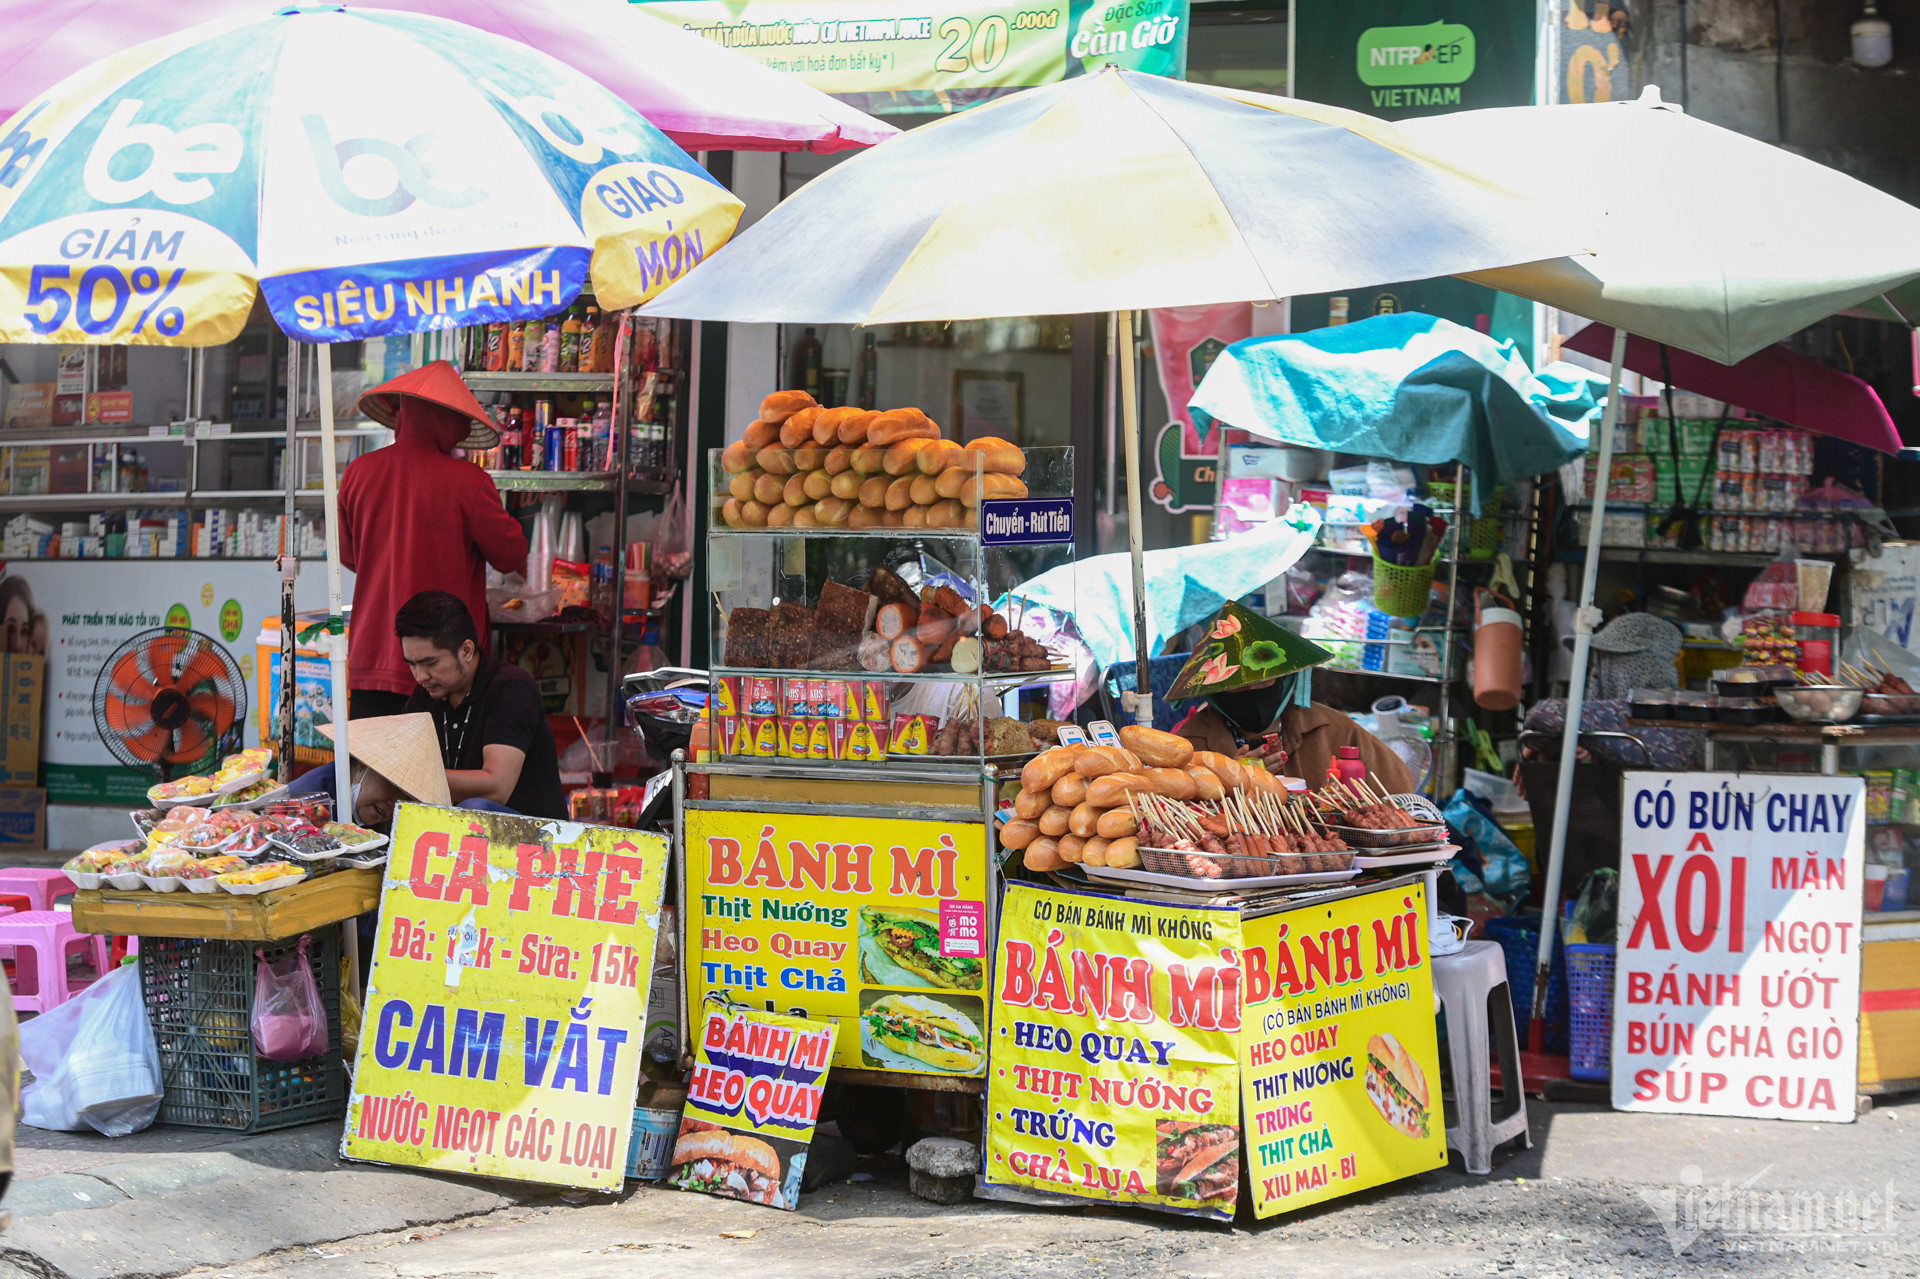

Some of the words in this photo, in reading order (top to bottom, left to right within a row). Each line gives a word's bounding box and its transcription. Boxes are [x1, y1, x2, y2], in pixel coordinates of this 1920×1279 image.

[1070, 20, 1127, 60] Cần
[1131, 14, 1180, 50] Giờ
[1370, 46, 1417, 67] NTFP
[1370, 87, 1461, 108] VIETNAM
[83, 99, 243, 205] be
[595, 168, 685, 220] GIAO
[59, 216, 185, 262] GIẢM
[634, 217, 705, 294] MÓN
[22, 263, 187, 337] 50%
[294, 280, 397, 332] SIÊU
[403, 268, 561, 317] NHANH
[985, 507, 1024, 536] Chuyển
[1030, 511, 1048, 533] Rút
[1048, 507, 1070, 532] Tiền
[1634, 779, 1675, 831] CÓ
[1688, 780, 1755, 832] BÚN
[1766, 792, 1852, 835] CHAY
[408, 820, 491, 907] CÀ
[508, 840, 643, 926] PHÊ
[706, 824, 874, 894] BÁNH
[888, 833, 961, 899] MÌ
[1771, 850, 1847, 899] MẶN
[701, 894, 753, 922] Thịt
[762, 898, 849, 928] Nướng
[1626, 832, 1748, 955] XÔI
[701, 928, 760, 954] Heo
[770, 933, 848, 962] Quay
[1033, 899, 1054, 922] CÓ
[1055, 902, 1082, 927] BÁN
[1085, 906, 1125, 932] BÁNH
[1131, 913, 1154, 937] MÌ
[1157, 915, 1214, 941] KHÔNG
[1764, 920, 1854, 963] NGỌT
[389, 915, 436, 962] Đá:
[518, 934, 581, 981] Sữa:
[589, 941, 640, 988] 15k
[1242, 923, 1366, 1007] BÁNH
[1374, 895, 1425, 977] MÌ
[702, 962, 768, 992] Thịt
[780, 967, 848, 994] Chả
[1000, 927, 1156, 1025] BÁNH
[1168, 947, 1242, 1033] MÌ
[1627, 963, 1741, 1008] BÁNH
[1760, 966, 1840, 1011] ƯỚT
[1262, 1010, 1285, 1036] (CÓ
[1285, 1003, 1312, 1026] BÁN
[1313, 996, 1350, 1021] BÁNH
[1350, 991, 1365, 1015] MÌ
[1365, 980, 1412, 1013] KHÔNG)
[373, 998, 506, 1084] CAM
[522, 996, 629, 1096] VẮT
[704, 1014, 791, 1063] BÁNH
[792, 1023, 832, 1070] MÌ
[1013, 1021, 1073, 1055] HEO
[1079, 1031, 1177, 1068] QUAY
[1249, 1037, 1287, 1068] HEO
[1290, 1024, 1341, 1058] QUAY
[1627, 1012, 1695, 1056] BÚN
[1706, 1012, 1775, 1060] CHẢ
[1786, 1016, 1844, 1061] GIÒ
[687, 1066, 747, 1105] HEO
[747, 1077, 825, 1123] QUAY
[1012, 1062, 1083, 1106] THỊT
[1088, 1072, 1215, 1116] NƯỚNG
[1252, 1072, 1289, 1103] THỊT
[1632, 1062, 1728, 1105] SÚP
[1744, 1074, 1837, 1112] CUA
[358, 1091, 428, 1147] NƯỚC
[432, 1105, 501, 1164] NGỌT
[503, 1107, 555, 1164] CÁC
[558, 1121, 618, 1180] LOẠI
[1010, 1107, 1117, 1149] TRỨNG
[1258, 1134, 1294, 1169] THỊT
[1296, 1121, 1334, 1157] CHẢ
[1008, 1146, 1081, 1186] CHẢ
[1082, 1162, 1151, 1198] LỤA
[1262, 1169, 1292, 1203] XÍU
[1292, 1158, 1328, 1193] MẠI
[1339, 1150, 1356, 1182] BÌ
